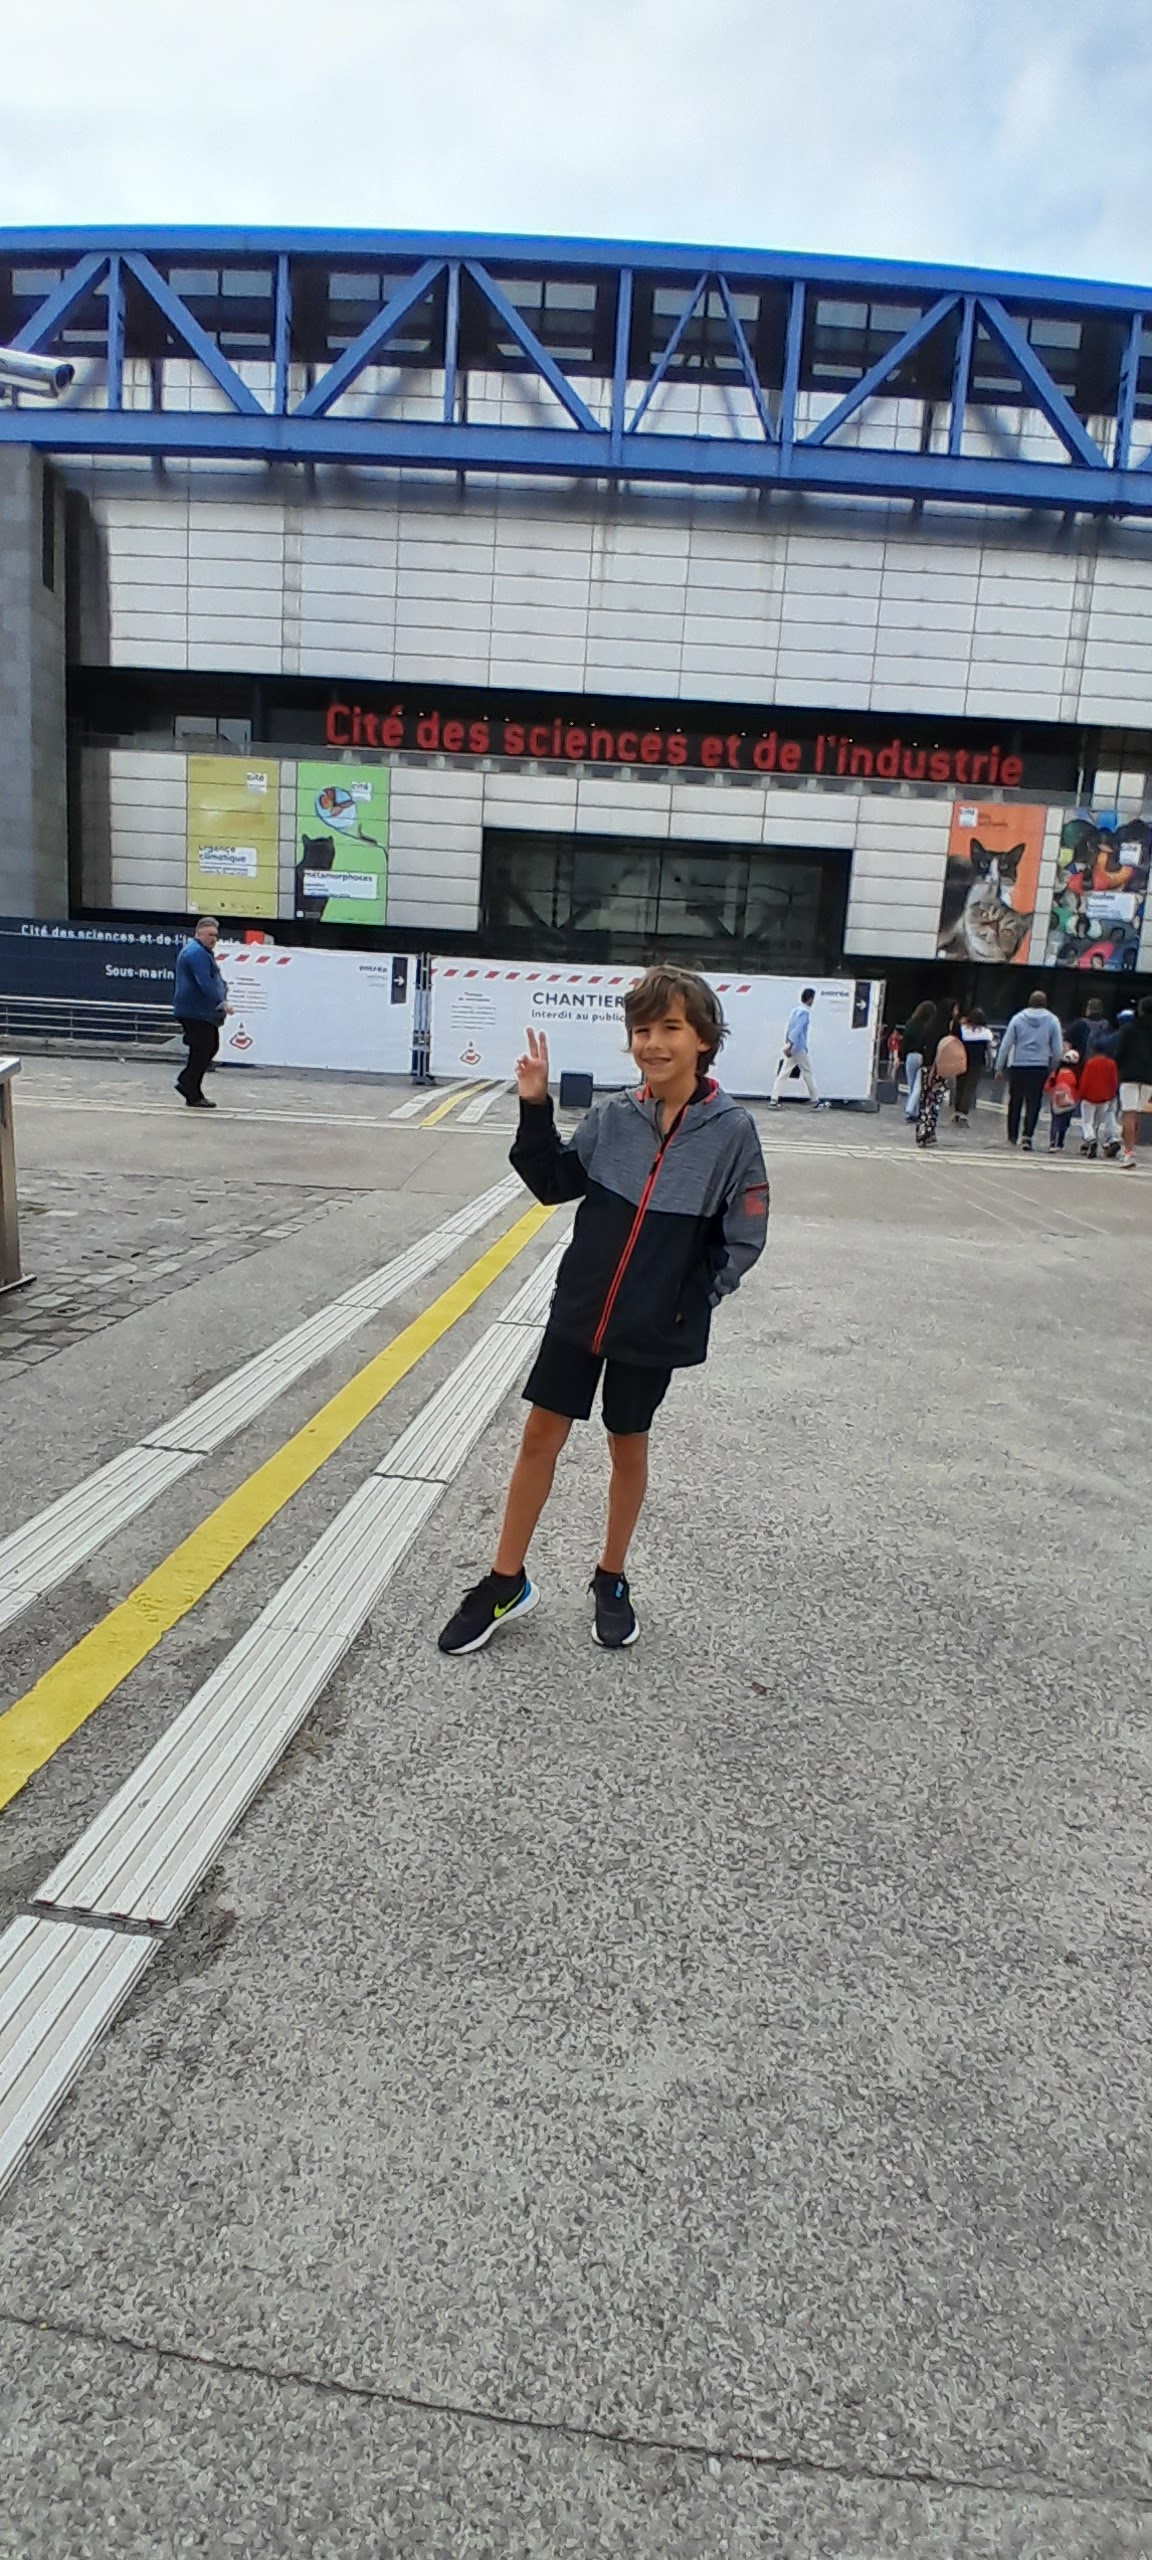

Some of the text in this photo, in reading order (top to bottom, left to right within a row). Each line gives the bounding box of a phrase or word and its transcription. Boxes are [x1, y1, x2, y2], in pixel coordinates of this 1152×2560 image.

[326, 704, 1023, 786] Cité des sciences et de l'industrie
[21, 924, 48, 936] Cité
[52, 926, 74, 938] des
[78, 928, 135, 942] sciences
[140, 932, 152, 944] et
[157, 932, 172, 945] de
[105, 964, 175, 980] Sous-marin
[533, 991, 626, 1008] CHANTIER
[576, 1012, 589, 1020] au
[592, 1011, 626, 1022] public
